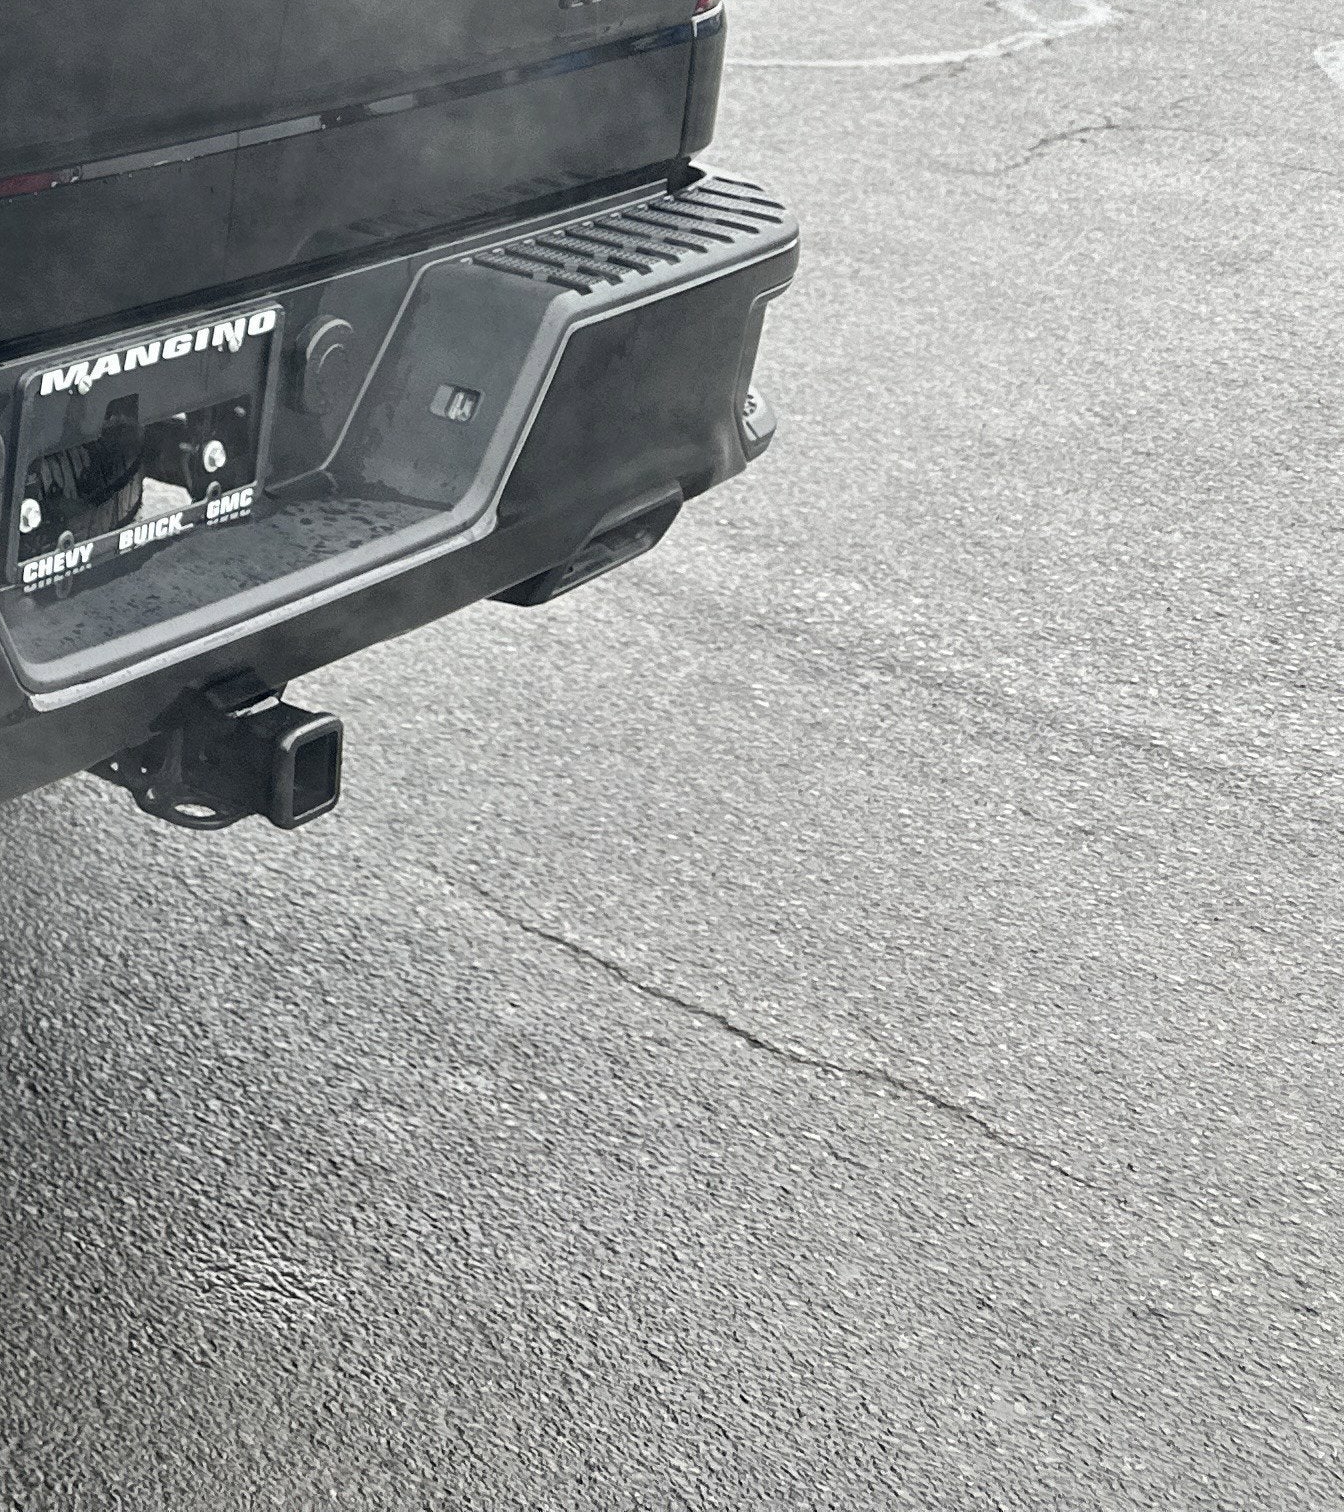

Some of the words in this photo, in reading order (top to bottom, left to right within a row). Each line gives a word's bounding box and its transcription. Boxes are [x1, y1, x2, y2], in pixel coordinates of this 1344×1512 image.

[39, 308, 277, 397] MANGINO
[22, 542, 95, 584] CHEVY
[118, 511, 186, 552] BUICK
[206, 487, 255, 521] GMC
